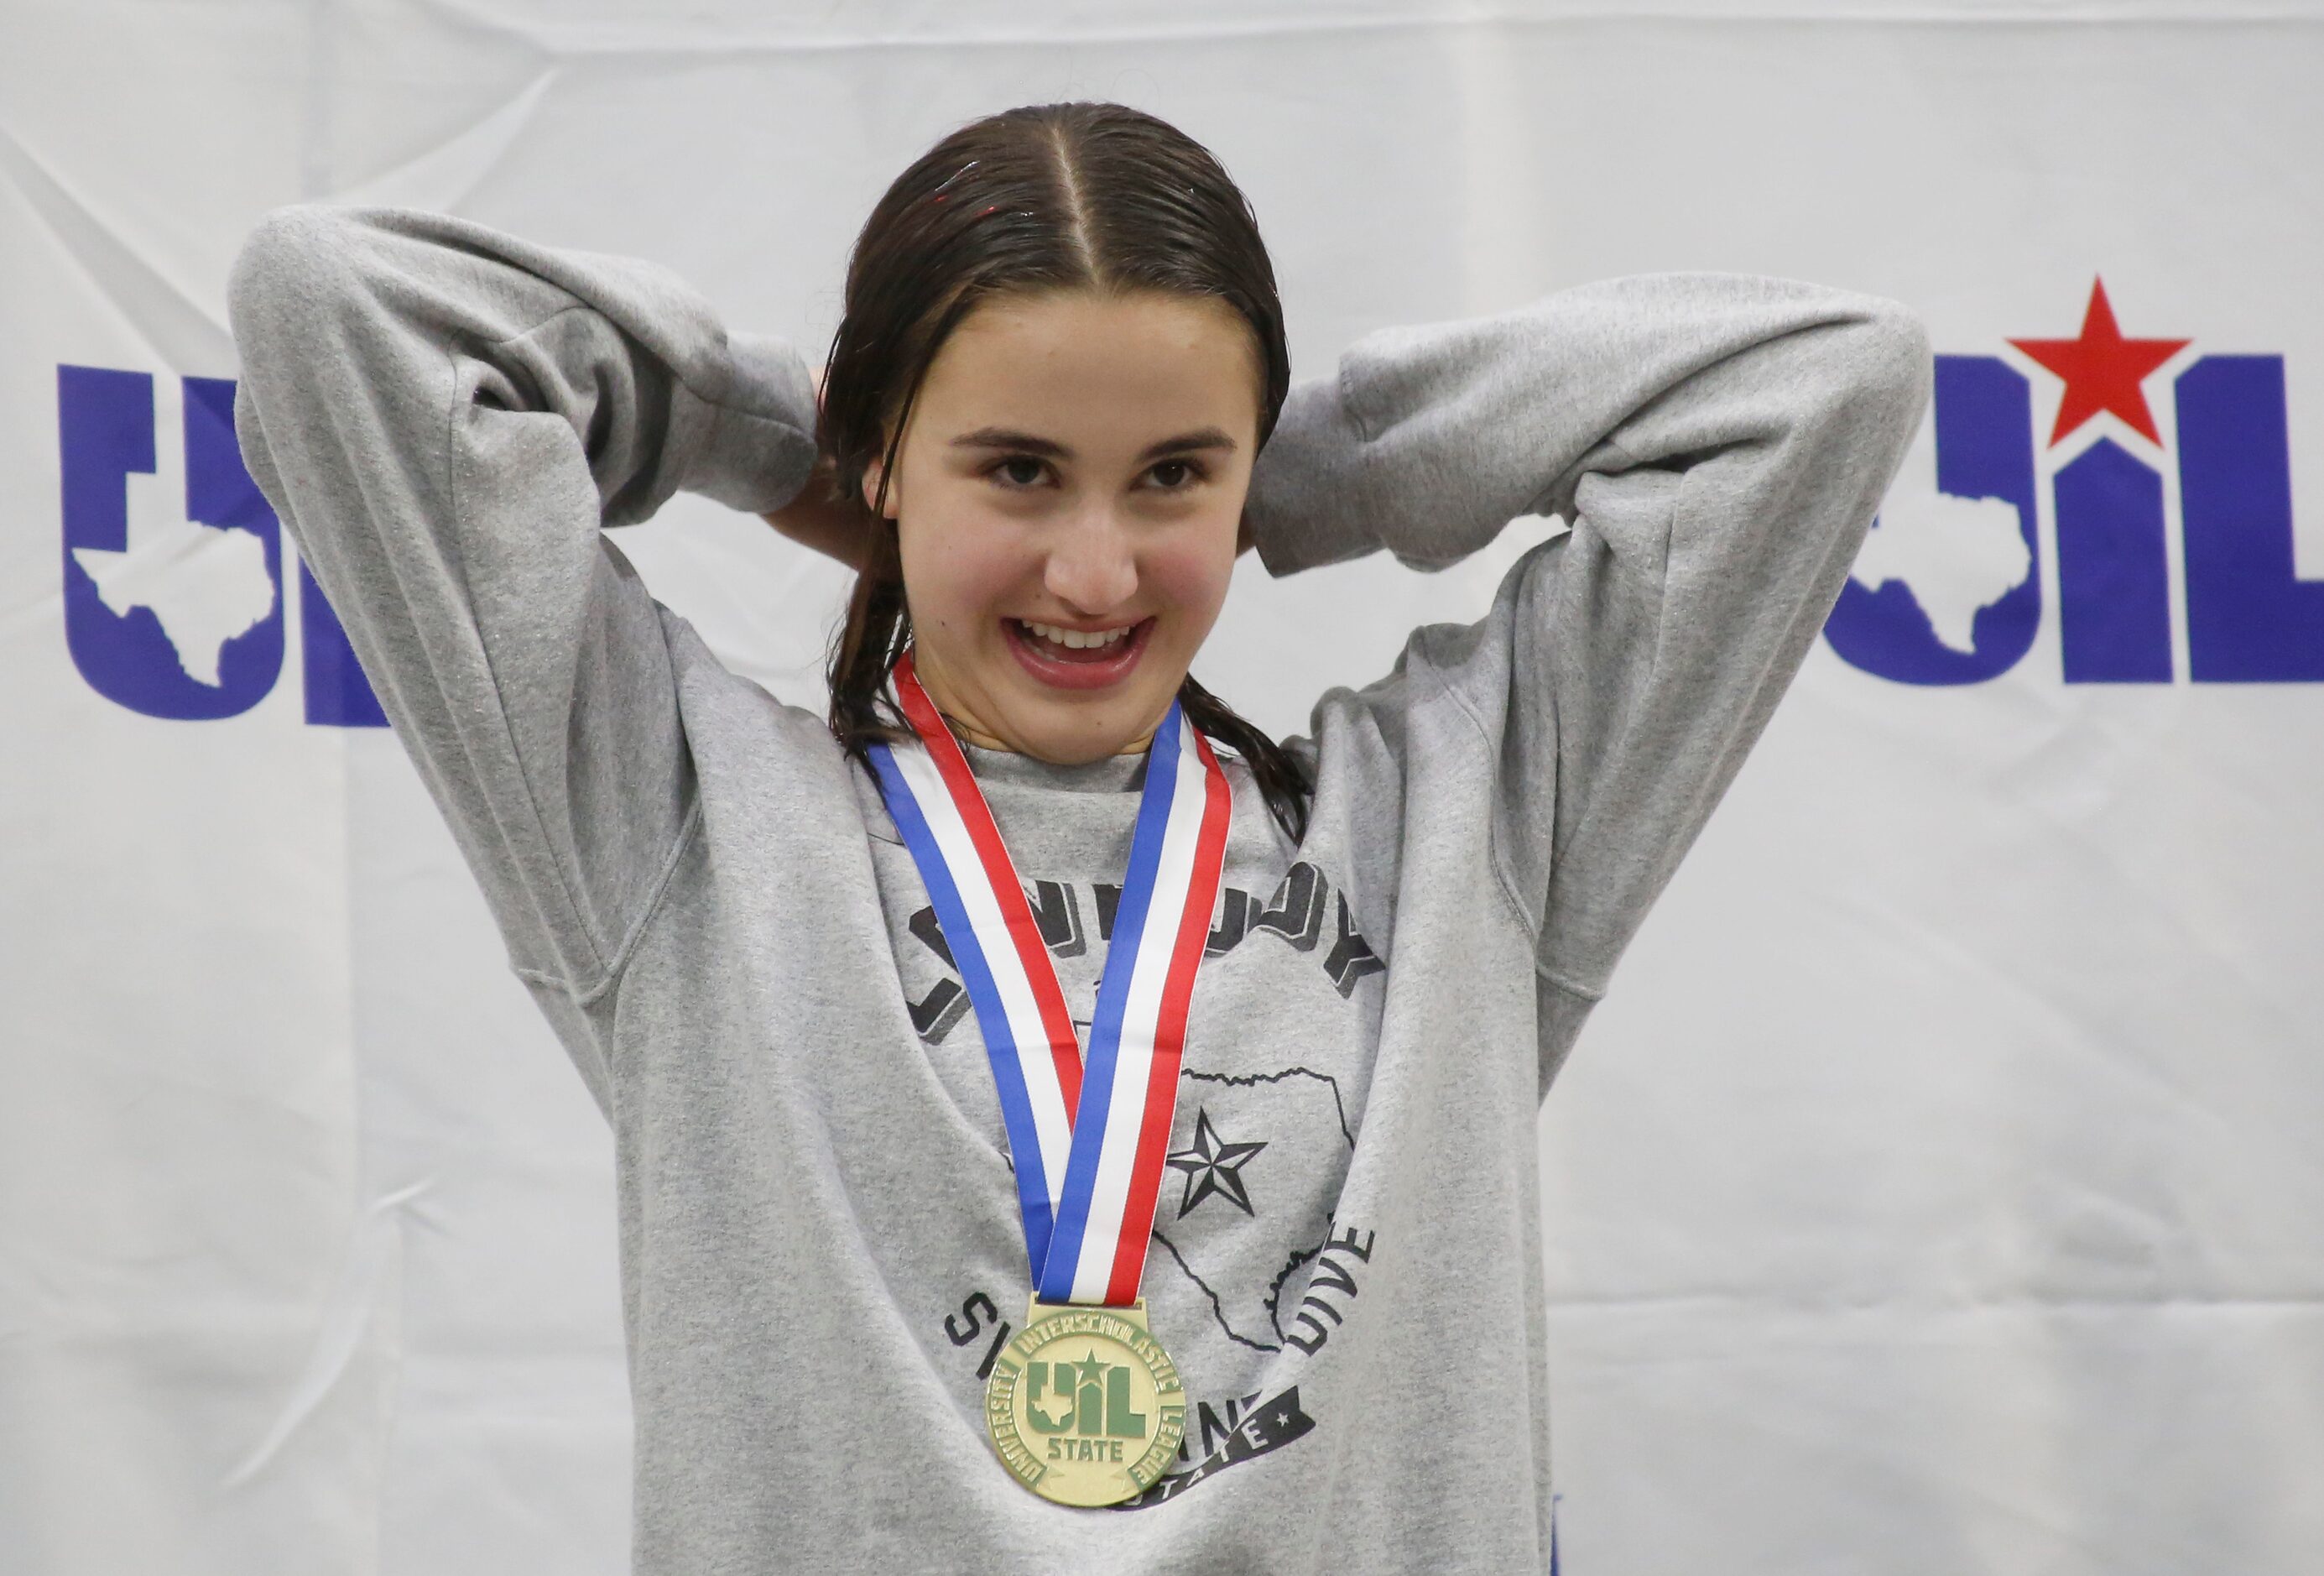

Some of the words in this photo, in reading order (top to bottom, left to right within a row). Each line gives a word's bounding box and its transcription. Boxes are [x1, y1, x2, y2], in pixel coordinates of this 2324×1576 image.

[1288, 1221, 1376, 1357] DIVE
[1015, 1313, 1180, 1394] INTERSCHOLASTIC
[990, 1361, 1043, 1482] UNIVERSITY
[1025, 1360, 1147, 1438] UIL
[1047, 1437, 1124, 1463] STATE
[1135, 1408, 1184, 1485] LEAGUE
